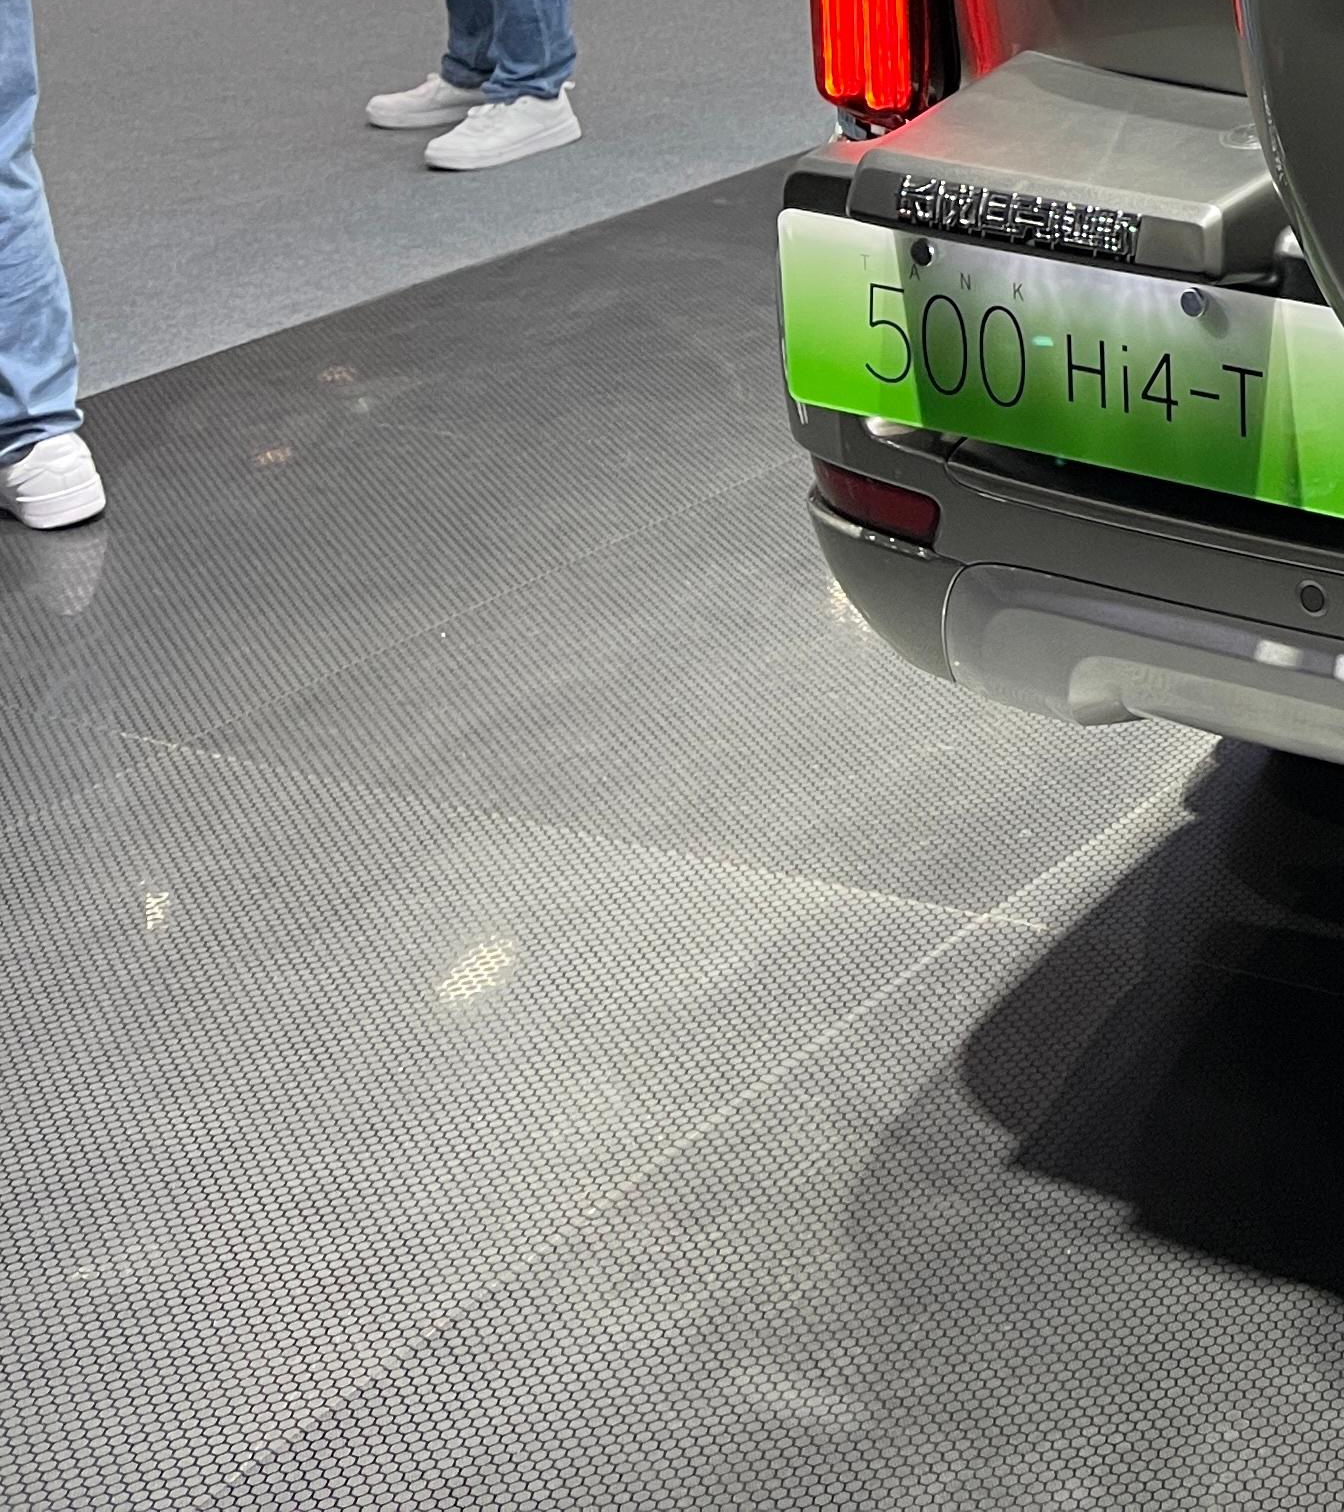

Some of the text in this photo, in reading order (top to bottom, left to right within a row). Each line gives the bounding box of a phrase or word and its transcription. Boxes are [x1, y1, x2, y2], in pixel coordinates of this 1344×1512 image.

[860, 253, 1025, 303] TANK
[865, 282, 1264, 438] 500 Hi4-T
